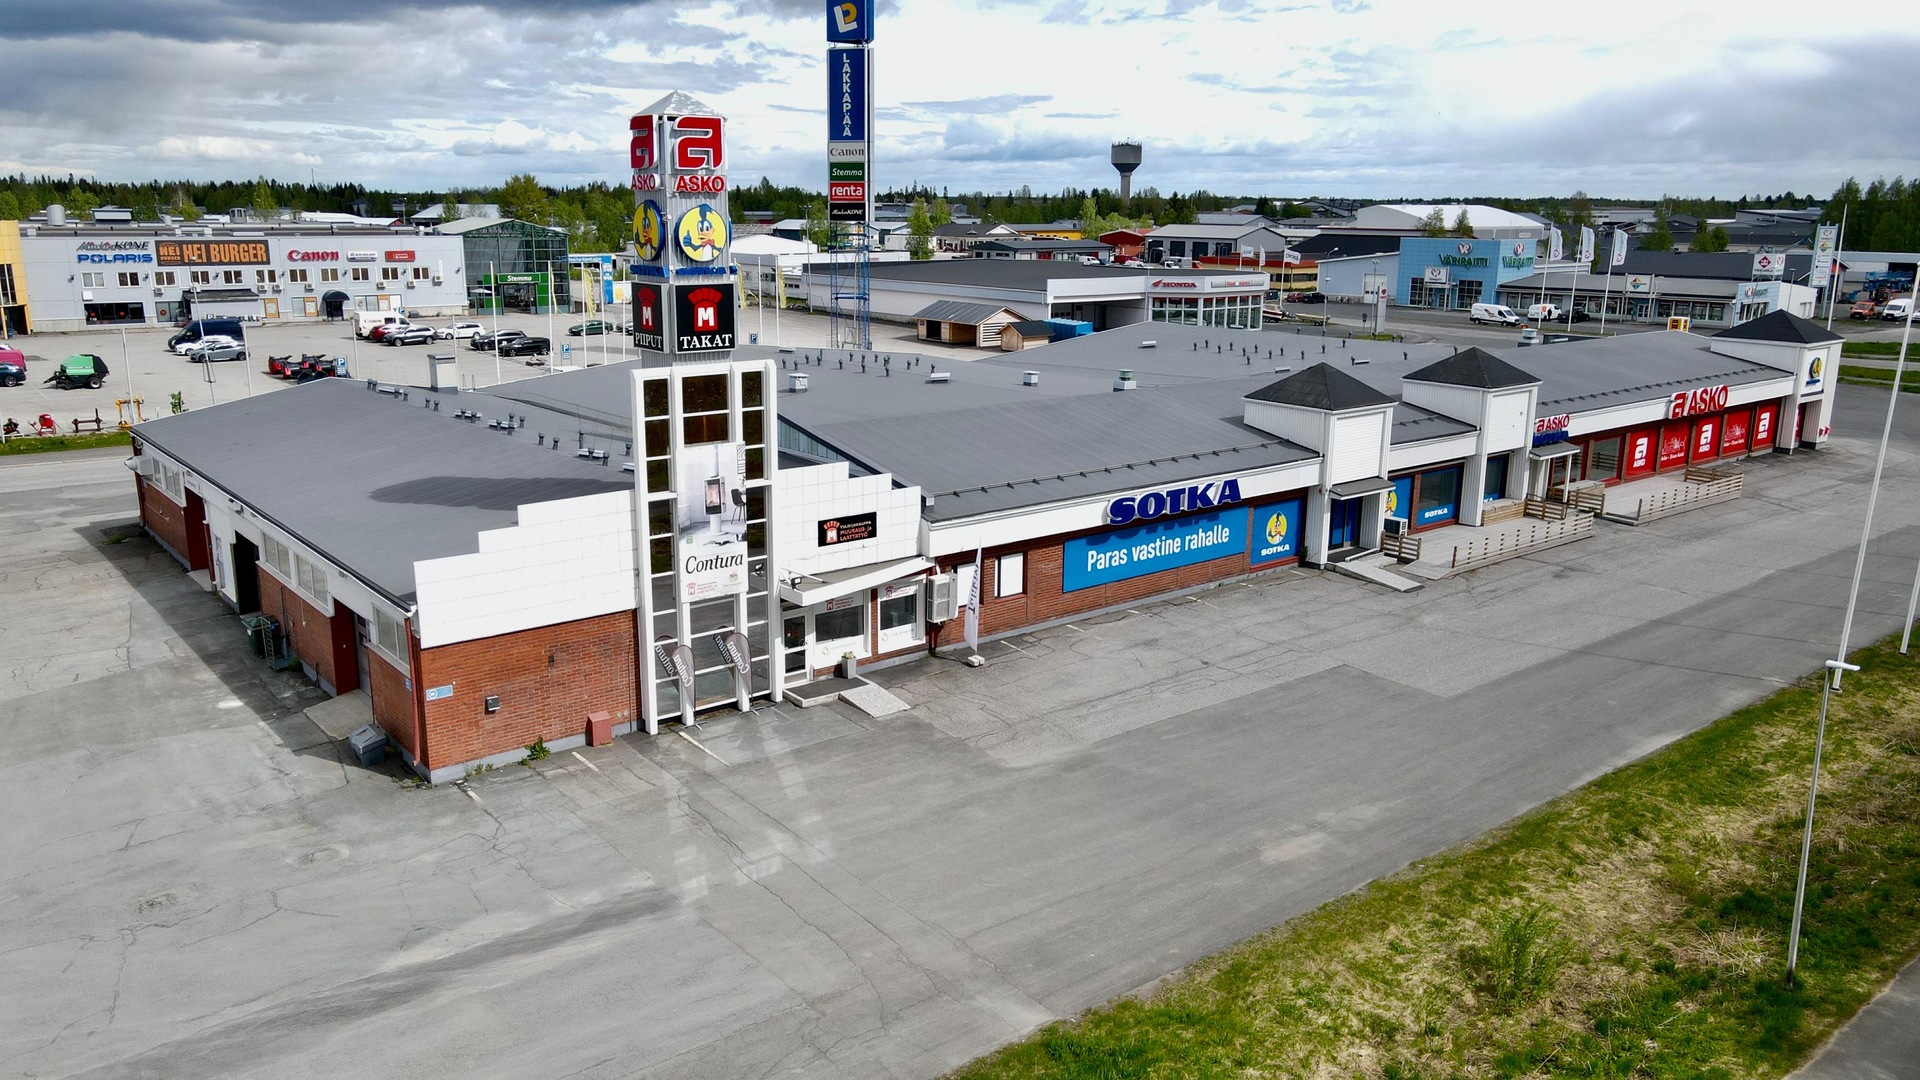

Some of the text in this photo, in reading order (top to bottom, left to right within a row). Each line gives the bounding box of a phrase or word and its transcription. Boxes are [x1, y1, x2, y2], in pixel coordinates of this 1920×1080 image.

[841, 52, 852, 137] LAKKAPÄÄ
[830, 147, 864, 157] Canon
[630, 174, 656, 191] ASKO
[676, 174, 726, 193] ASKO
[831, 184, 863, 196] renta
[76, 253, 154, 264] POLARIS
[182, 243, 268, 263] HEI BURGER
[286, 249, 340, 262] Canon
[1162, 281, 1198, 289] HONDA
[697, 306, 715, 328] M
[634, 330, 663, 349] PIIPUT
[679, 333, 733, 349] TAKAT
[1686, 384, 1729, 417] ASKO
[1546, 414, 1570, 431] ASKO
[1109, 478, 1242, 526] SOTKA
[1424, 507, 1448, 519] SOTKA
[1087, 524, 1230, 572] Paras vastine rahalle
[1260, 543, 1291, 557] SOTKA
[685, 553, 744, 575] Contura
